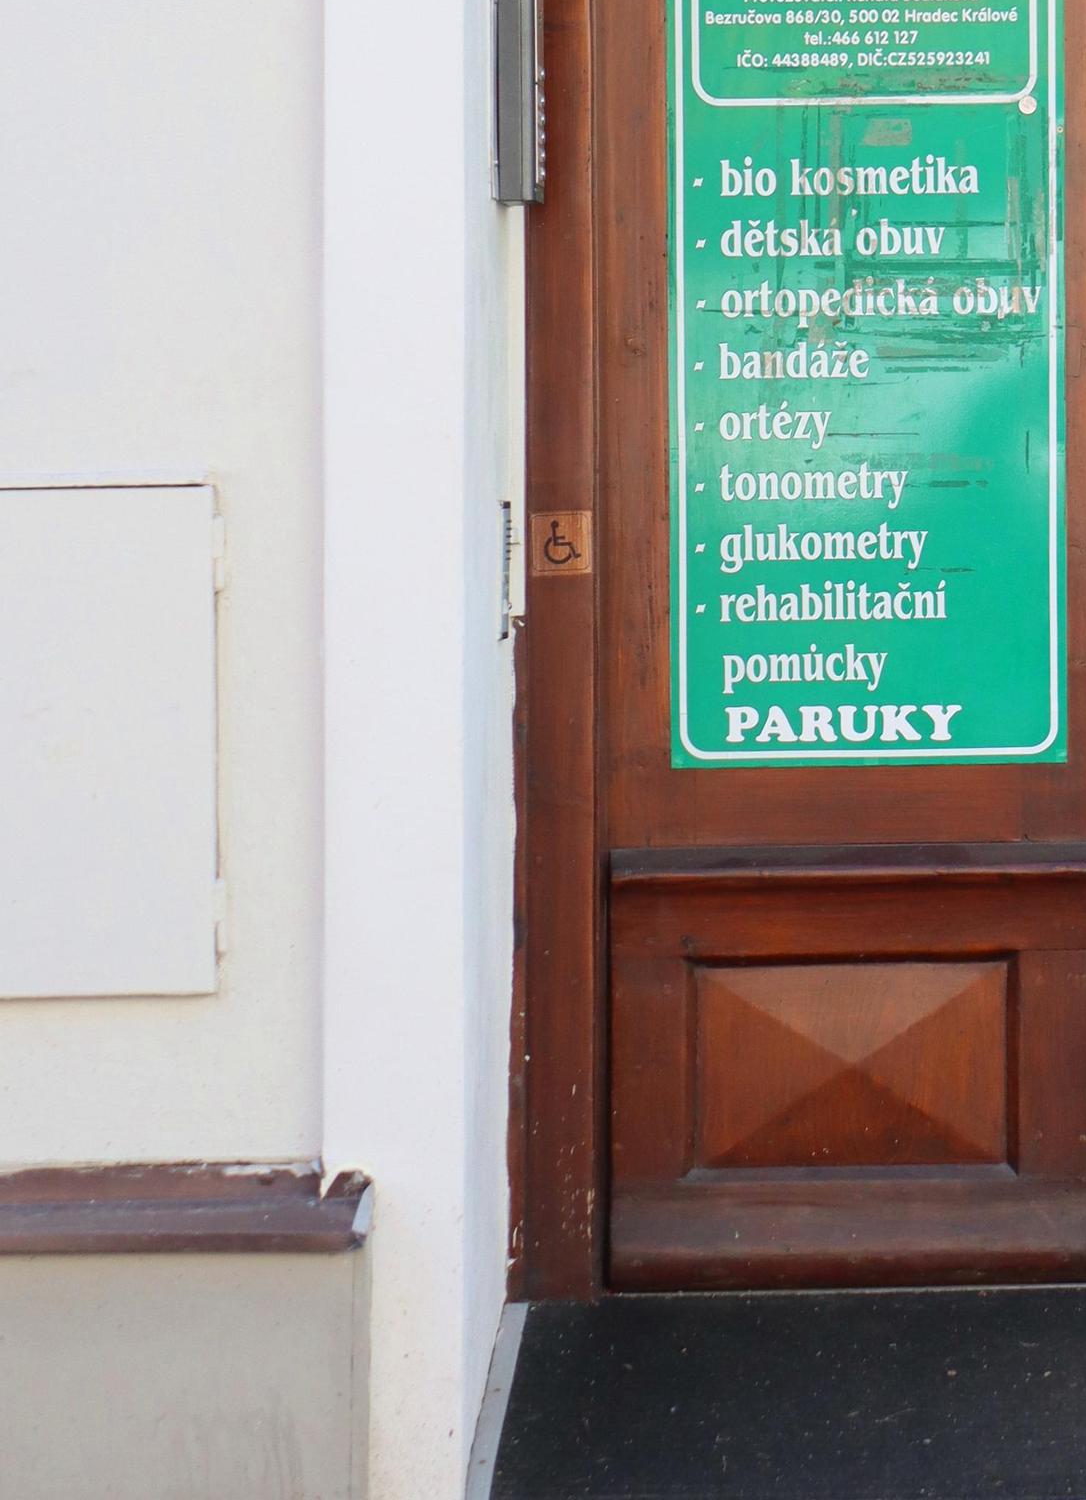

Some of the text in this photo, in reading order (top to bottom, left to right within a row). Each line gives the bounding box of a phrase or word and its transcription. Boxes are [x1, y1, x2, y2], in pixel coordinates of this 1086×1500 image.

[705, 7, 1017, 25] Bezručova 868/30, 500 02 Hradec Králové
[737, 48, 990, 69] IČO: 44388489, DIČ:CZ525923241
[804, 30, 918, 46] tel.:466 612 127
[720, 156, 777, 197] bio
[790, 154, 979, 195] kosmetika
[720, 217, 842, 257] dětská
[856, 218, 946, 255] obuv
[720, 275, 939, 328] ortopedická
[953, 277, 1042, 317] obuv
[719, 339, 870, 380] bandáže
[719, 401, 832, 449] ortézy
[720, 461, 909, 509] tonometry
[720, 522, 928, 573] glukometry
[720, 579, 947, 622] rehabilitační
[724, 704, 962, 743] PARUKY
